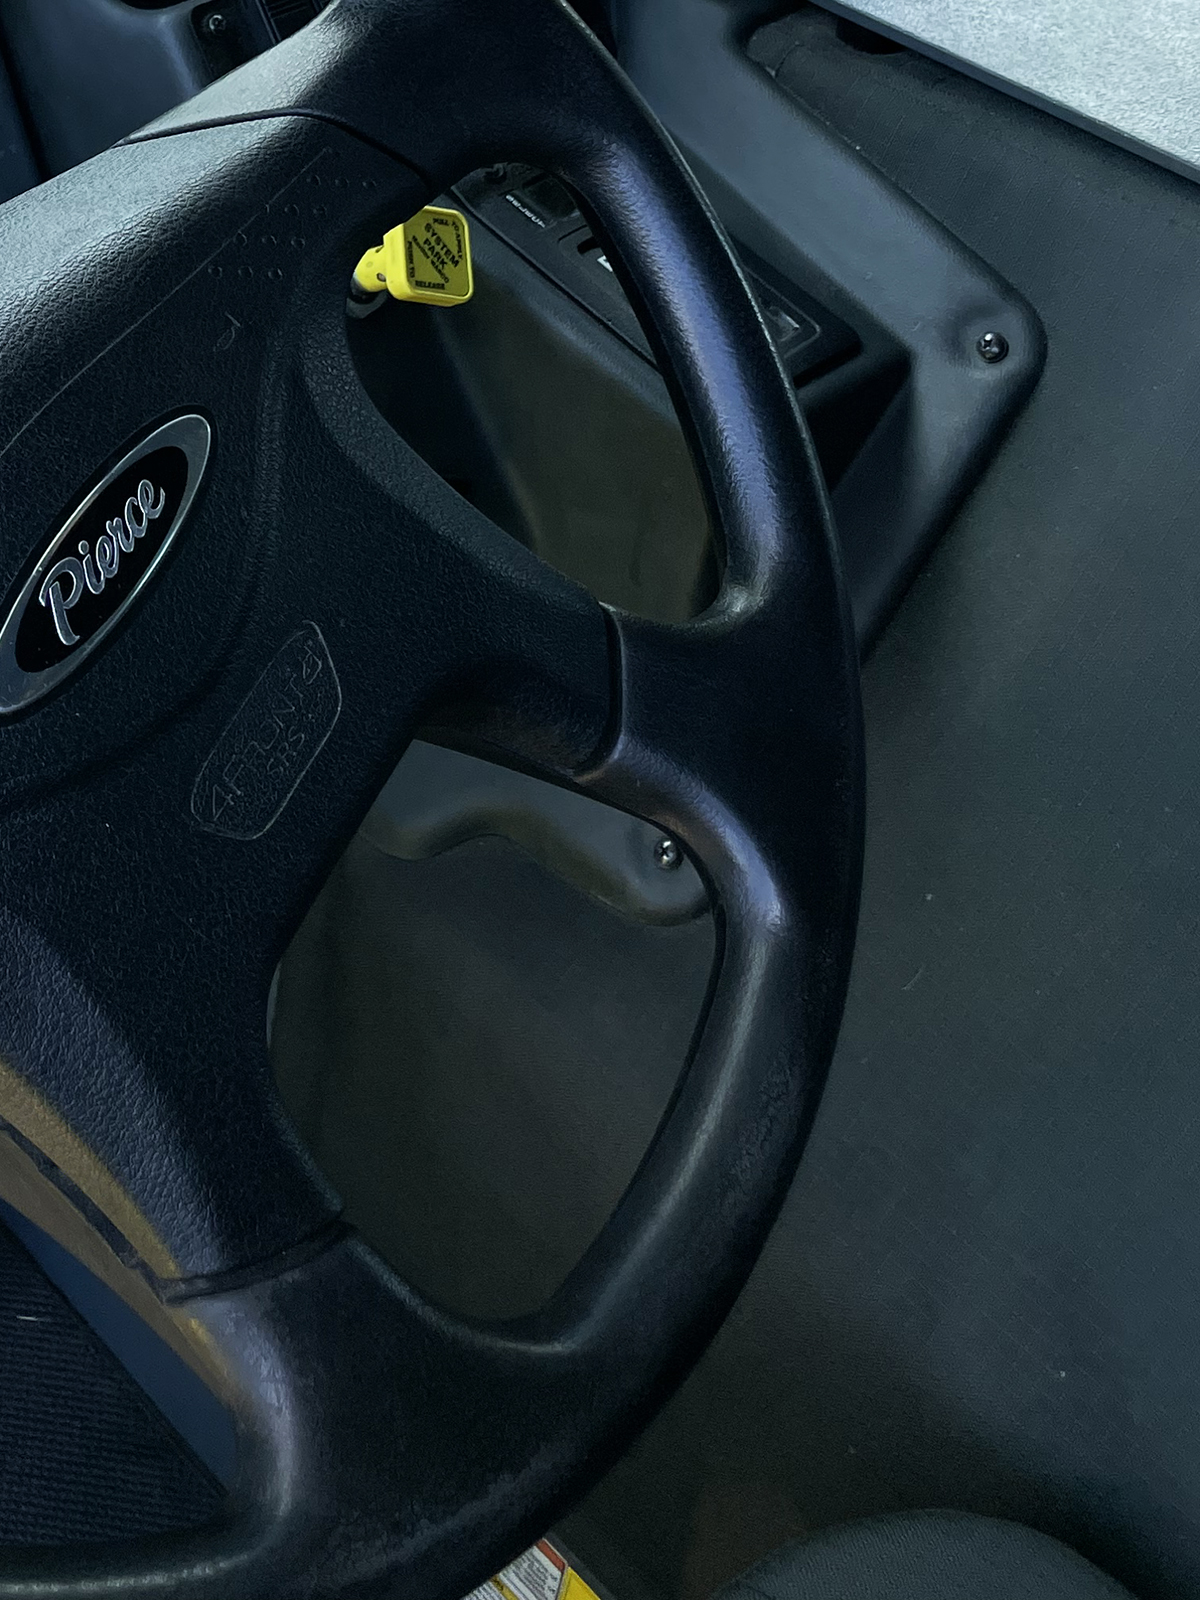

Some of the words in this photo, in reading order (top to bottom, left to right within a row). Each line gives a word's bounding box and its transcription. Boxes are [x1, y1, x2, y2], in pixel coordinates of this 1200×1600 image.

[423, 238, 448, 270] PARK
[424, 222, 460, 268] SYSTEM
[38, 478, 167, 646] Pierce
